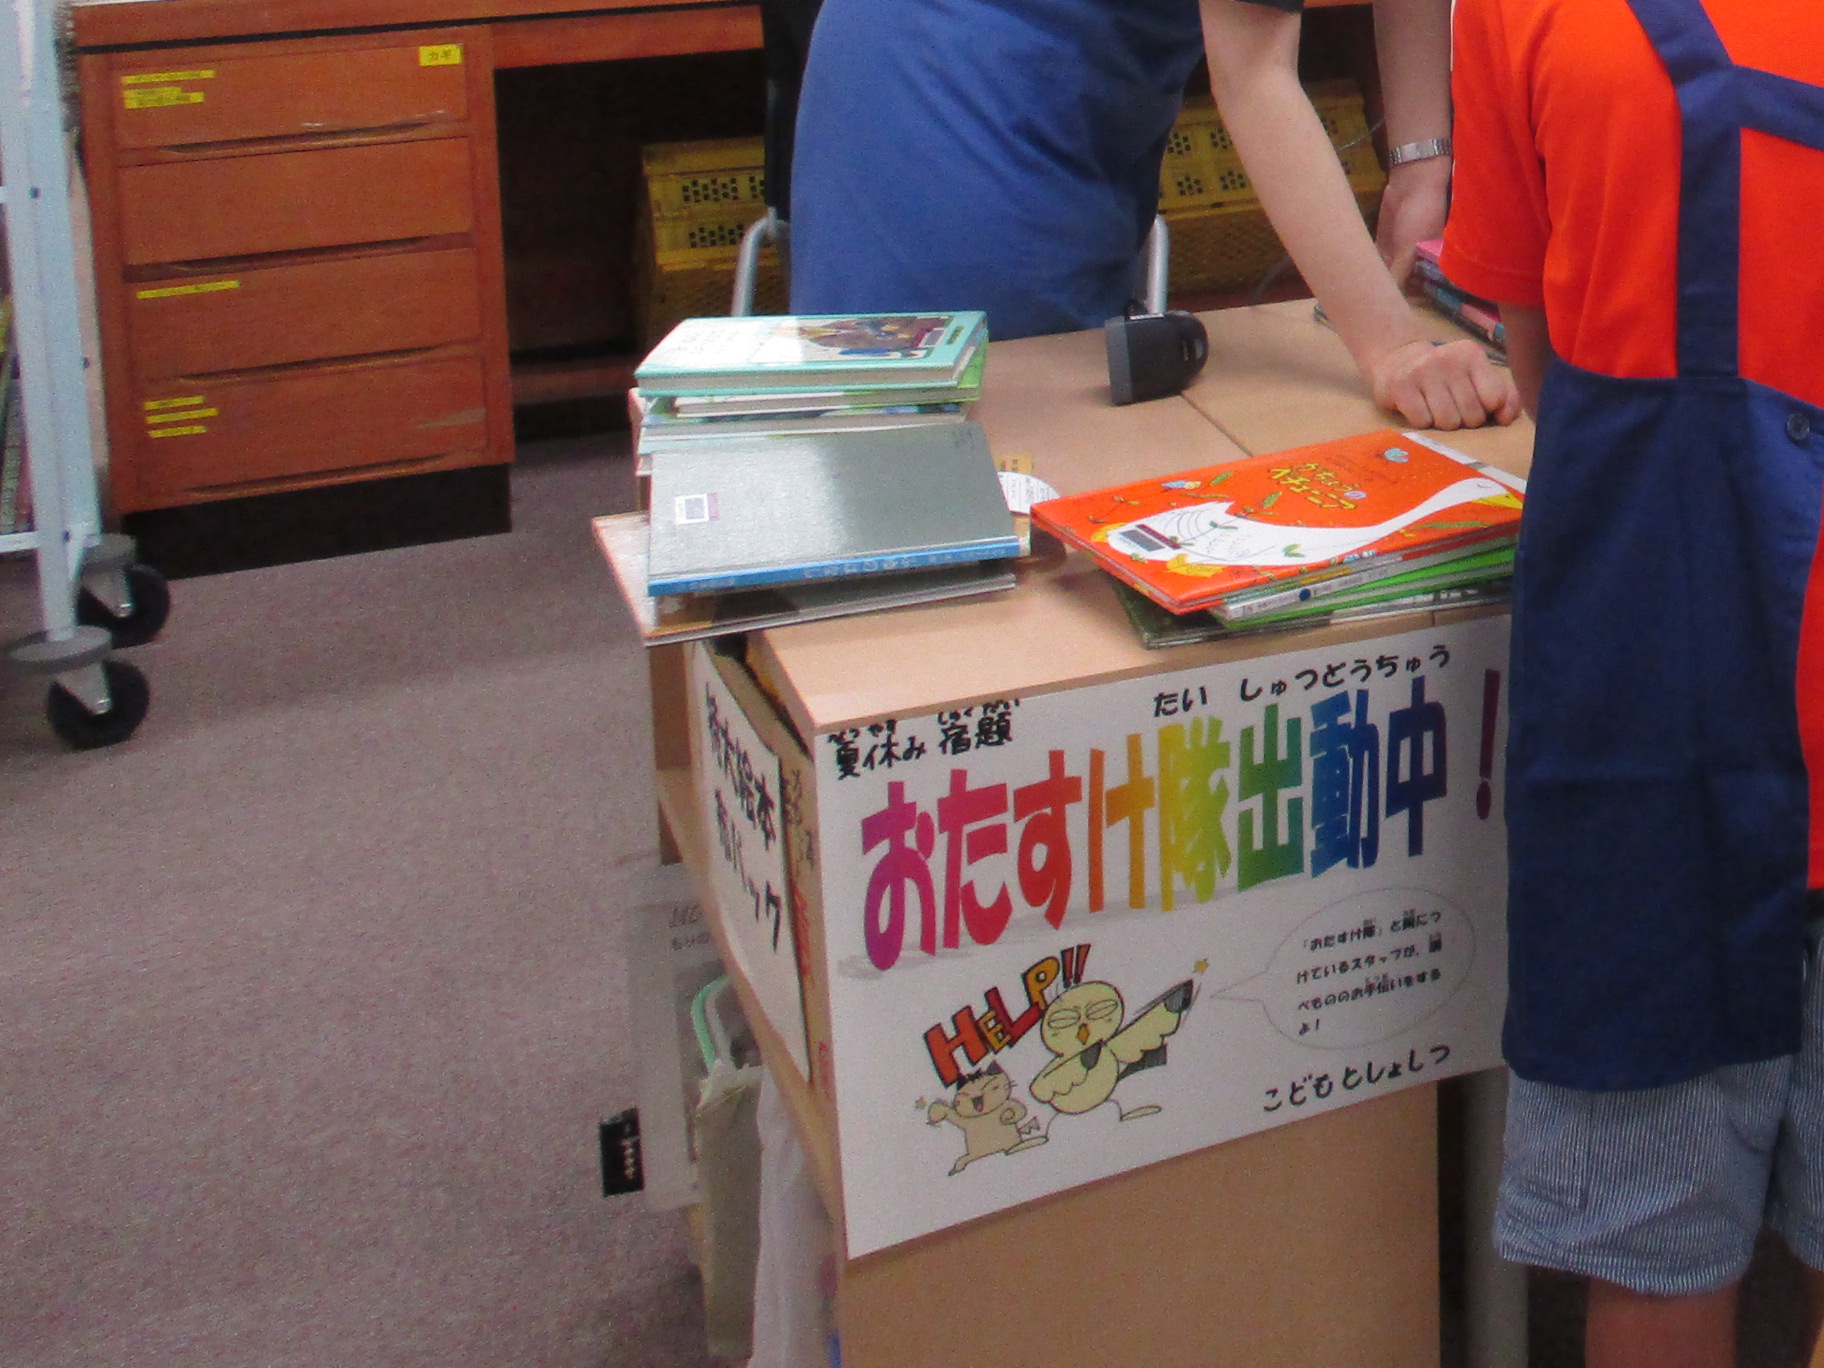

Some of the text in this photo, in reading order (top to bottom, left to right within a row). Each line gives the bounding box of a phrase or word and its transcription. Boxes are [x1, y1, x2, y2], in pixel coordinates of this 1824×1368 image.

[1154, 644, 1451, 717] たい しゅつどうちゅう
[834, 712, 1013, 781] 夏休み 宿題
[923, 943, 1092, 1089] HELP!!
[1263, 1043, 1451, 1113] こどもとしょしつ
